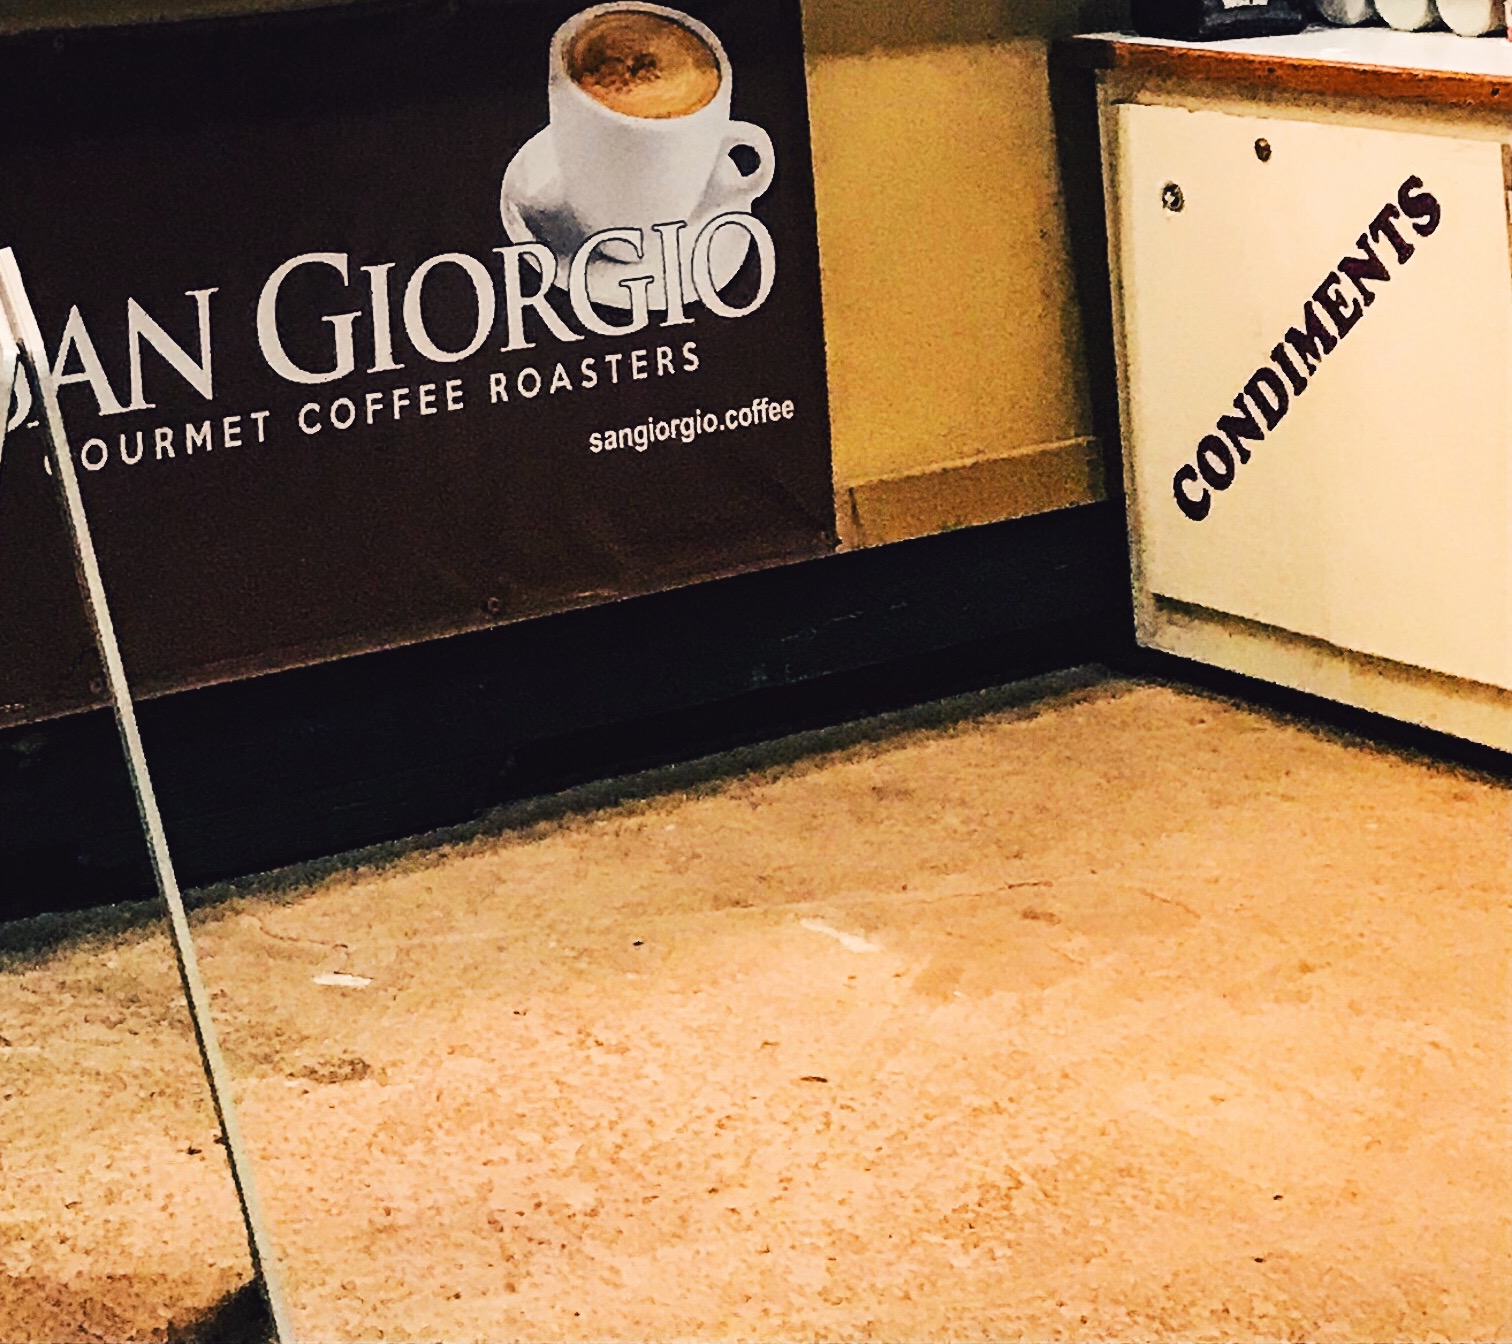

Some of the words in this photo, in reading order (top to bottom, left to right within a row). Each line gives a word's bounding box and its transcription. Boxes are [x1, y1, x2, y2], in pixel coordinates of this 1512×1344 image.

[256, 211, 776, 385] GIORGIO
[1173, 174, 1441, 521] CONDIMENTS
[44, 409, 271, 477] OURMET
[297, 378, 465, 436] COFFEE
[489, 341, 701, 404] ROASTERS
[589, 398, 796, 454] sangiorgio.coffee
